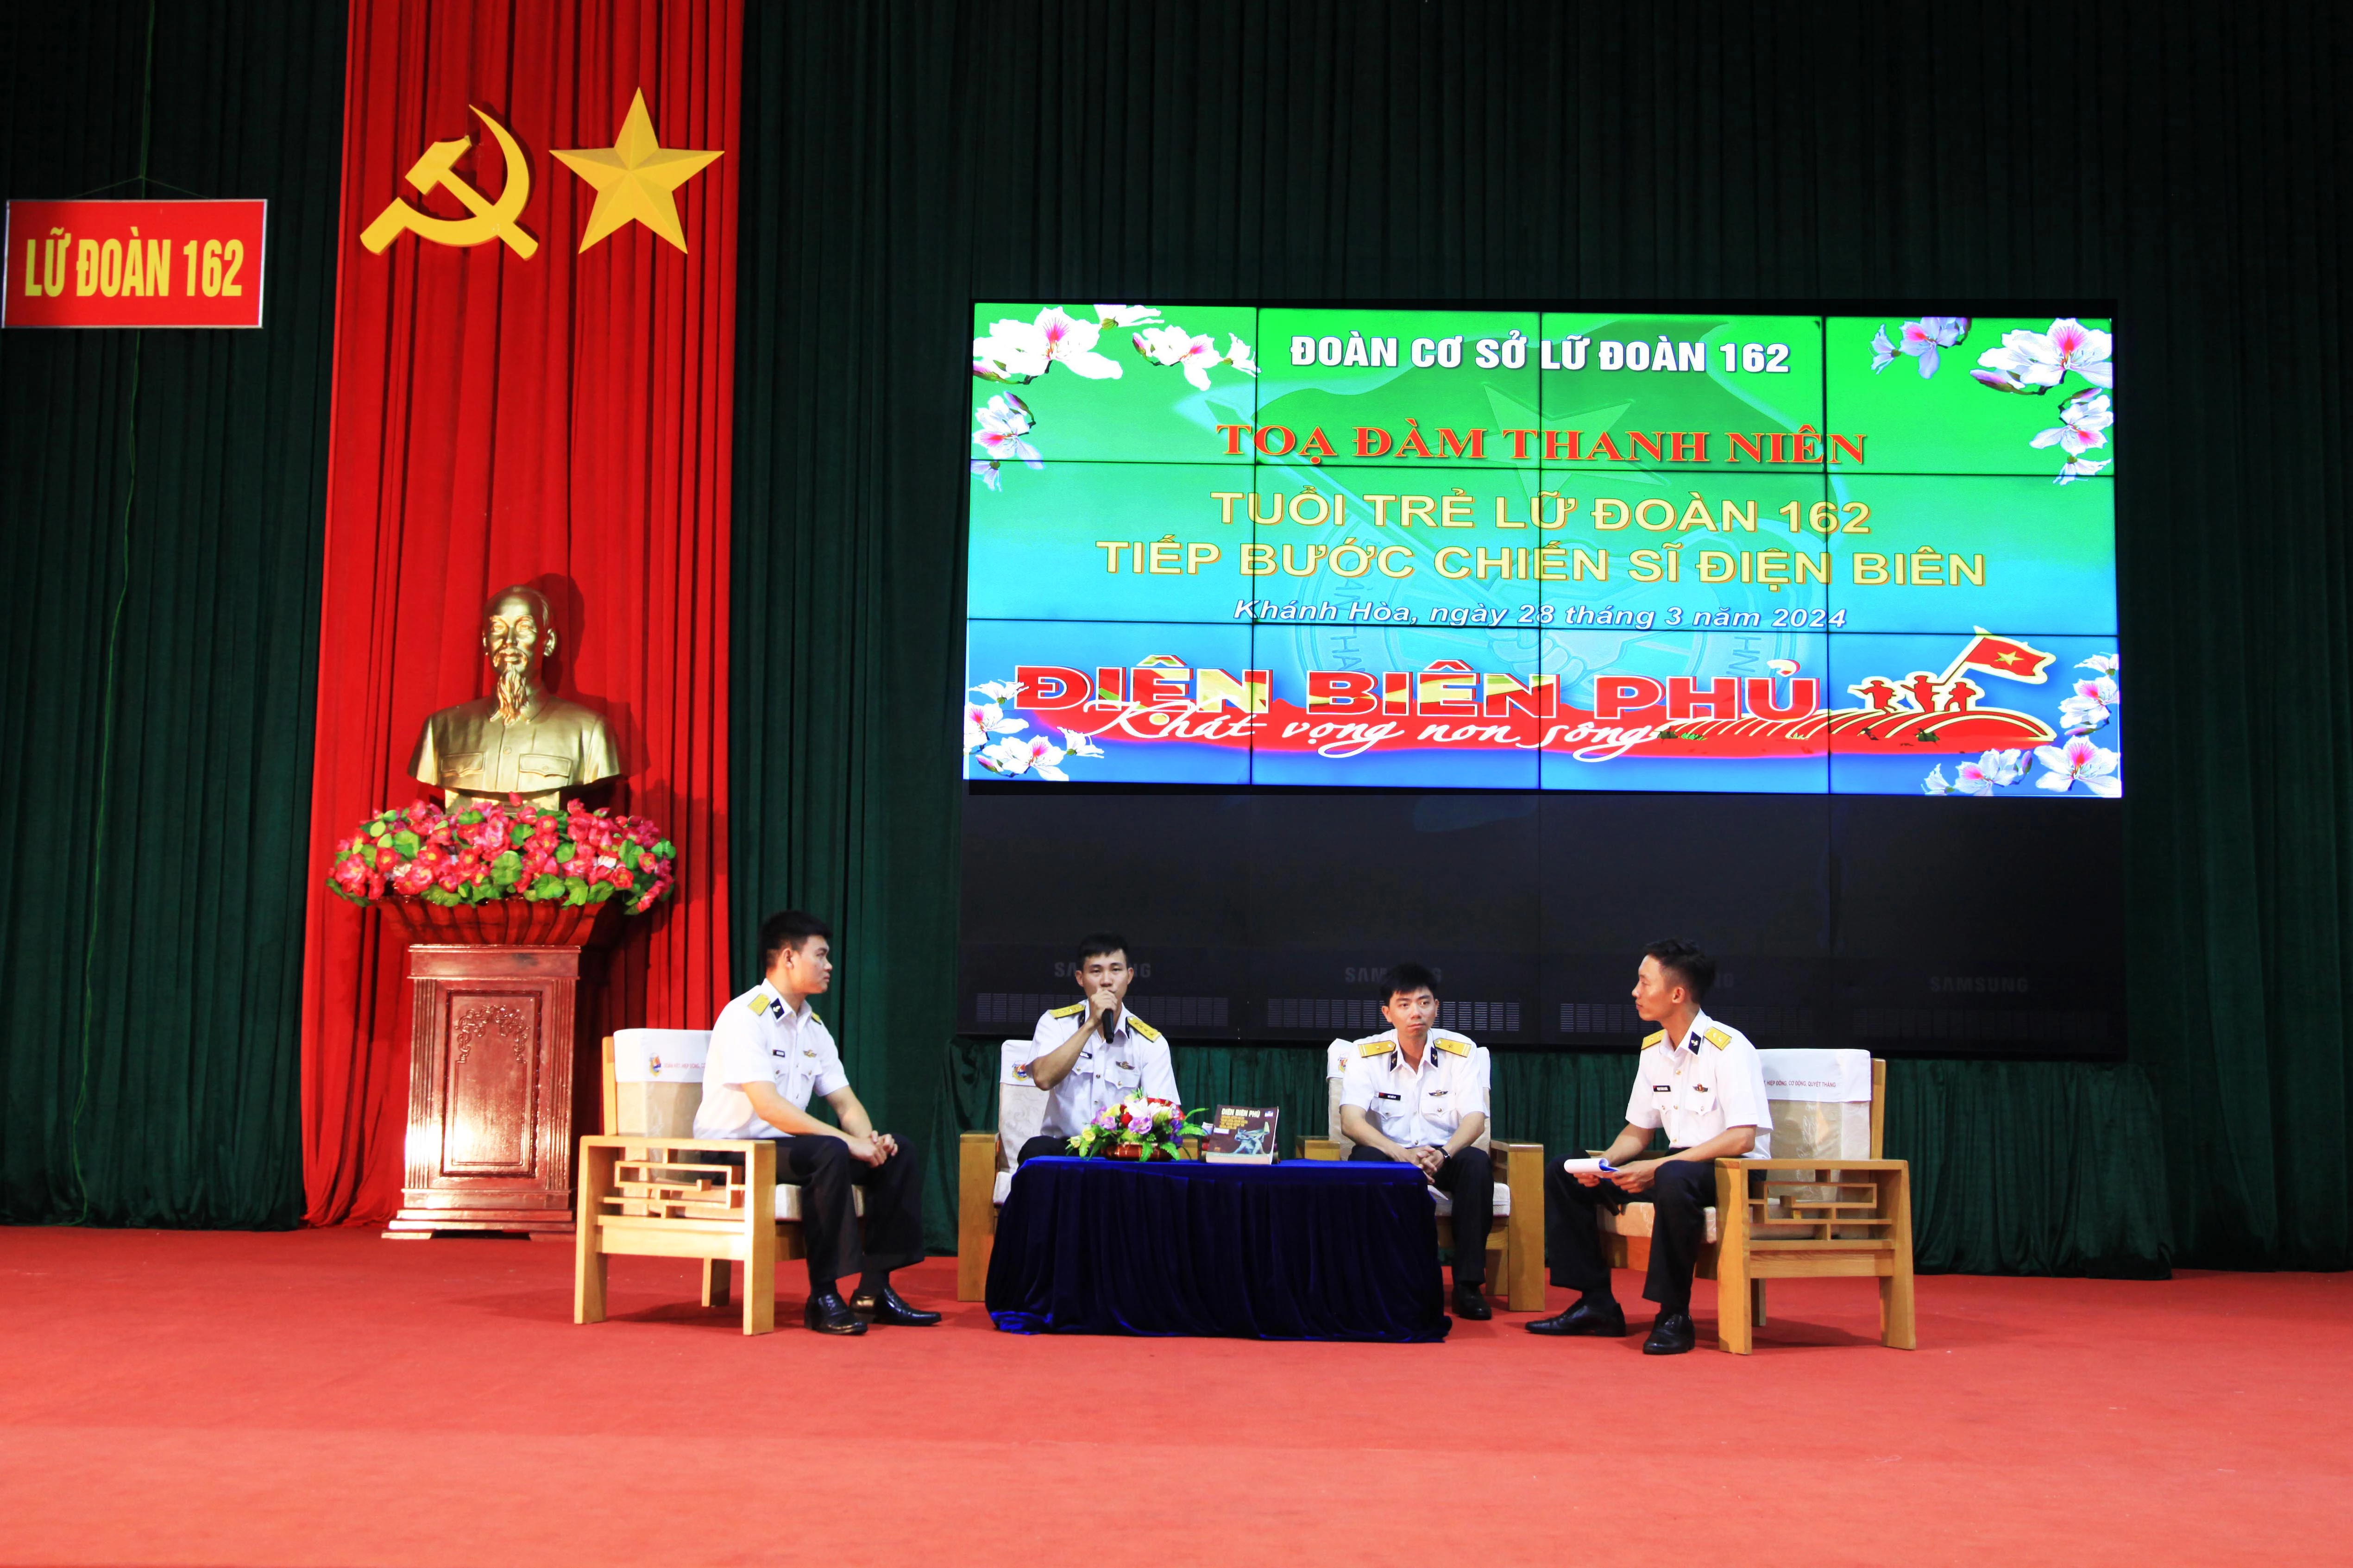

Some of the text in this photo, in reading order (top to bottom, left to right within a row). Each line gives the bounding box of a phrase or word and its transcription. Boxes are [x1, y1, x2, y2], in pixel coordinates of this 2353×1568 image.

[25, 226, 244, 297] LỮ ĐOÀN 162
[1290, 329, 1790, 373] ĐOÀN CƠ SỞ LỮ ĐOÀN 162
[1216, 418, 1867, 464] TOẠ ĐÀM THANH NIÊN
[1210, 485, 1872, 534] TUỔI TRẺ LỮ ĐOÀN 162
[1095, 534, 1986, 592] TIẾP BƯỚC CHIẾN SĨ ĐIỆN BIÊN
[1233, 599, 1847, 630] Khánh Hòa, ngày 28 tháng 3 năm 2024
[1306, 659, 1560, 718] BIÊN
[1593, 659, 1820, 723] PHỦ
[1083, 695, 1659, 763] Khát vọng non sông
[1929, 976, 2028, 992] SAMSUNG
